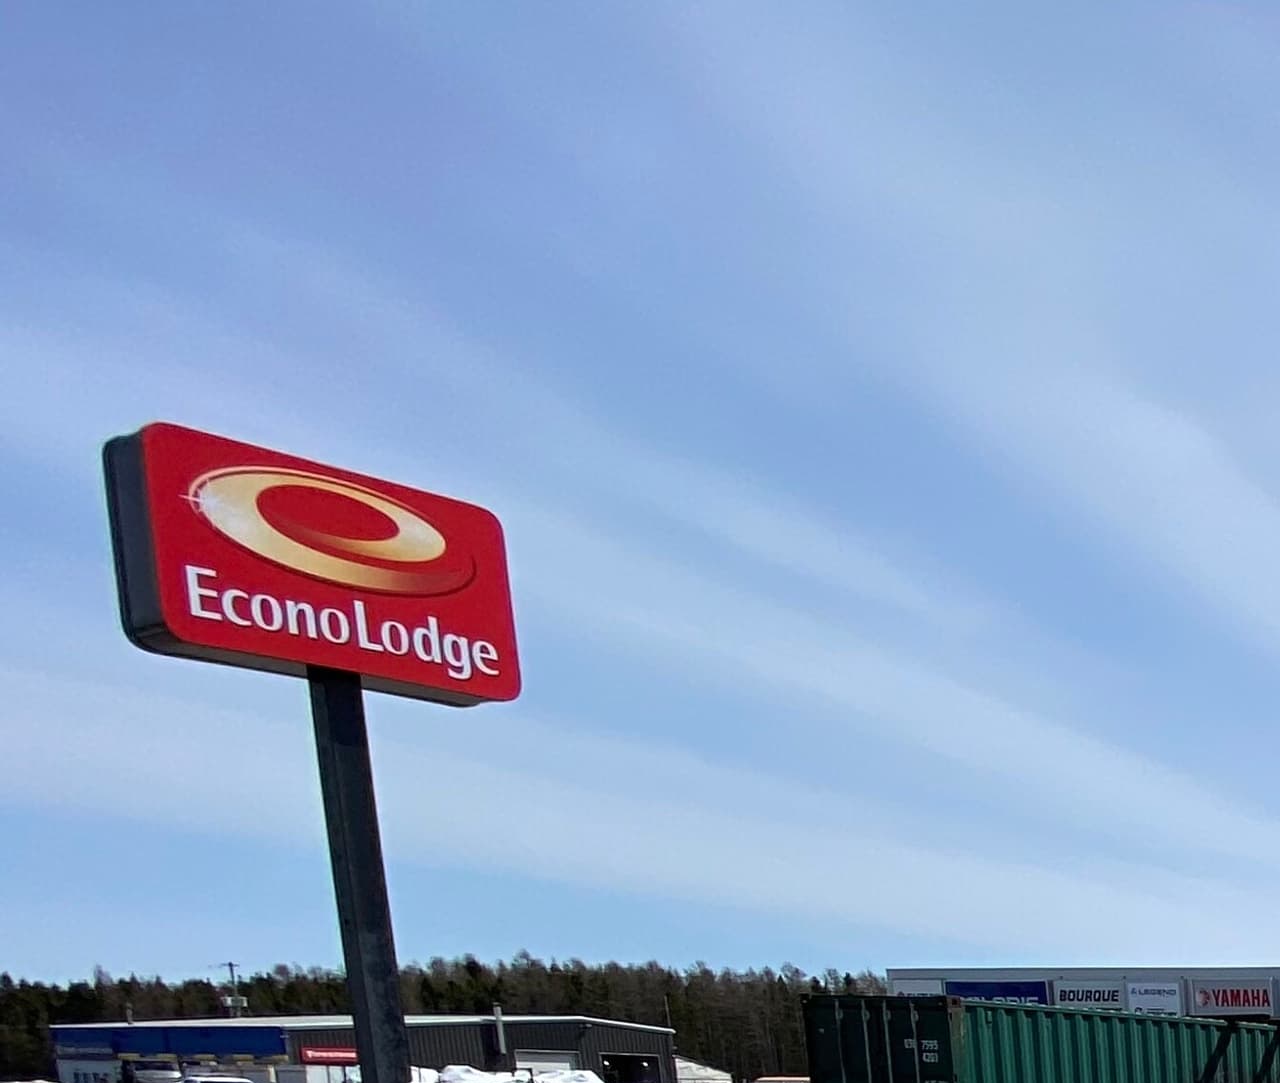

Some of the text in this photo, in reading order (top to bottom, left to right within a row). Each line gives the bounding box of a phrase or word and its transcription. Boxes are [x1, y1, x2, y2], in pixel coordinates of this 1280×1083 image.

[184, 564, 499, 681] EconoLodge
[1059, 989, 1119, 1002] BOURQUE
[1213, 989, 1270, 1007] YAMAHA
